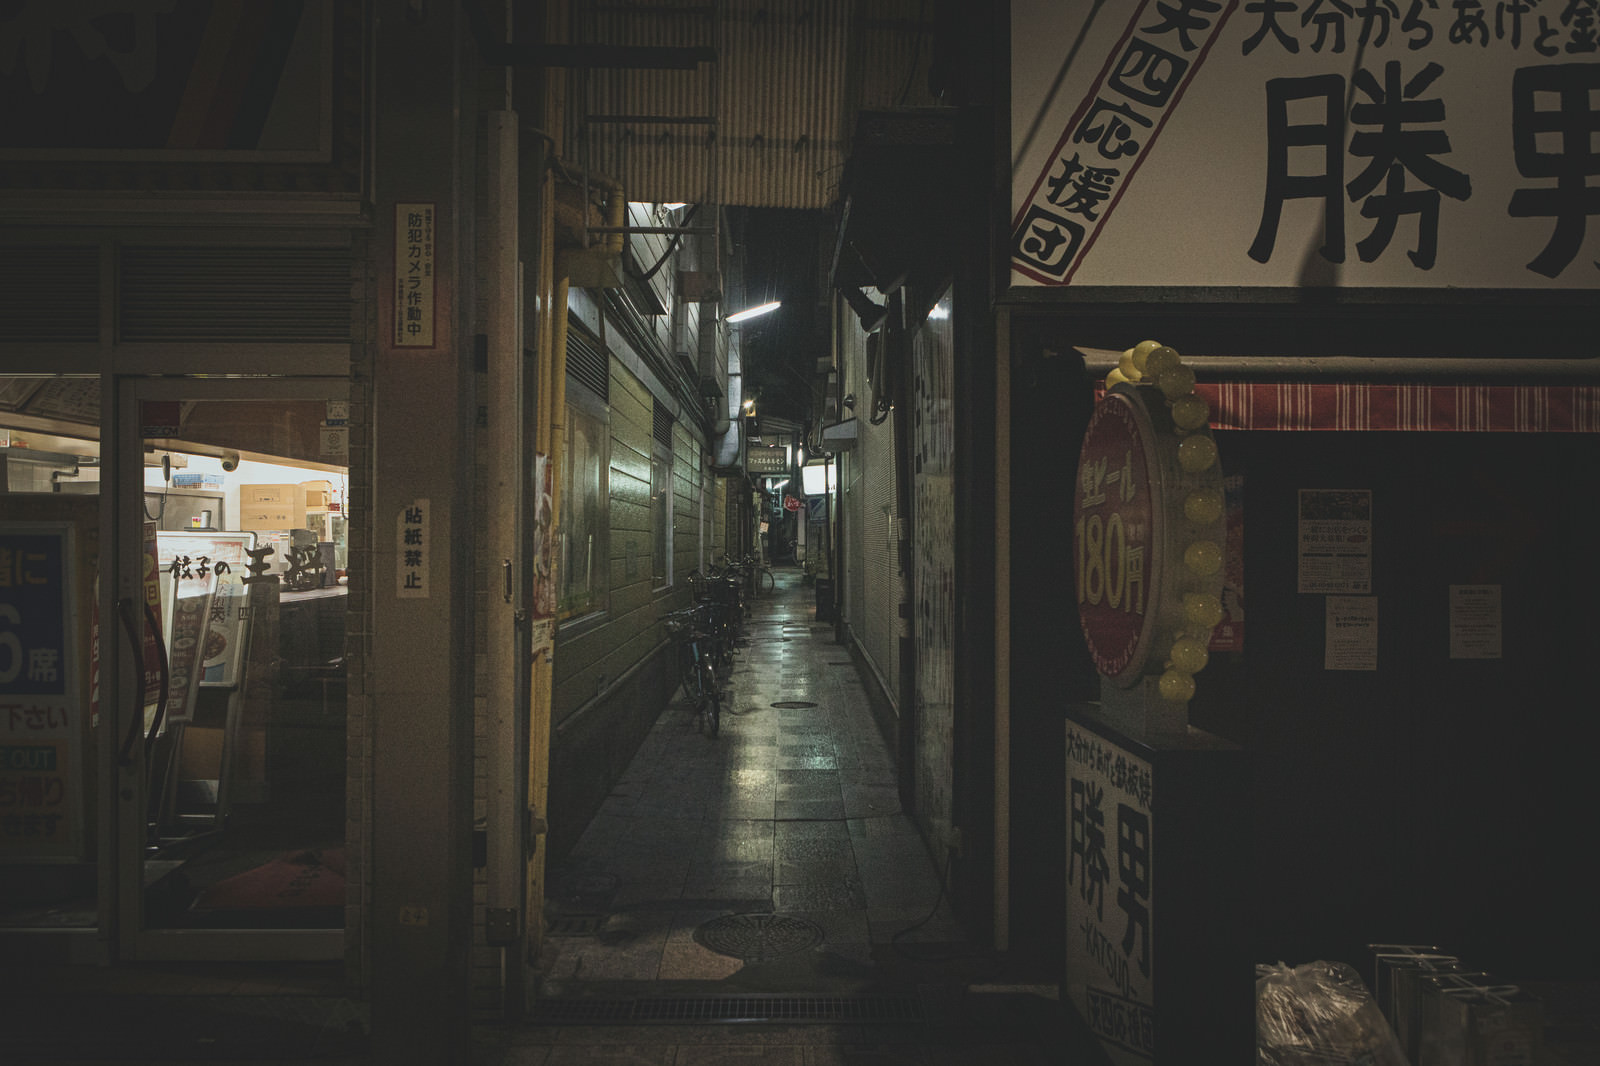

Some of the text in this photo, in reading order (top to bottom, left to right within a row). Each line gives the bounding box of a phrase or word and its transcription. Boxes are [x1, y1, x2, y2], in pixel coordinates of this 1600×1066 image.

[1011, 0, 1222, 277] 天四応援団
[1247, 60, 1600, 279] 勝男
[407, 213, 422, 337] 防犯カメラ作動中
[1081, 450, 1136, 510] 生ビール
[168, 542, 326, 592] 餃子の王将
[404, 506, 423, 589] 貼紙禁止
[1075, 512, 1145, 615] 180円
[0, 704, 69, 732] 下さい
[11, 749, 52, 769] OUT
[1070, 777, 1150, 980] 勝男
